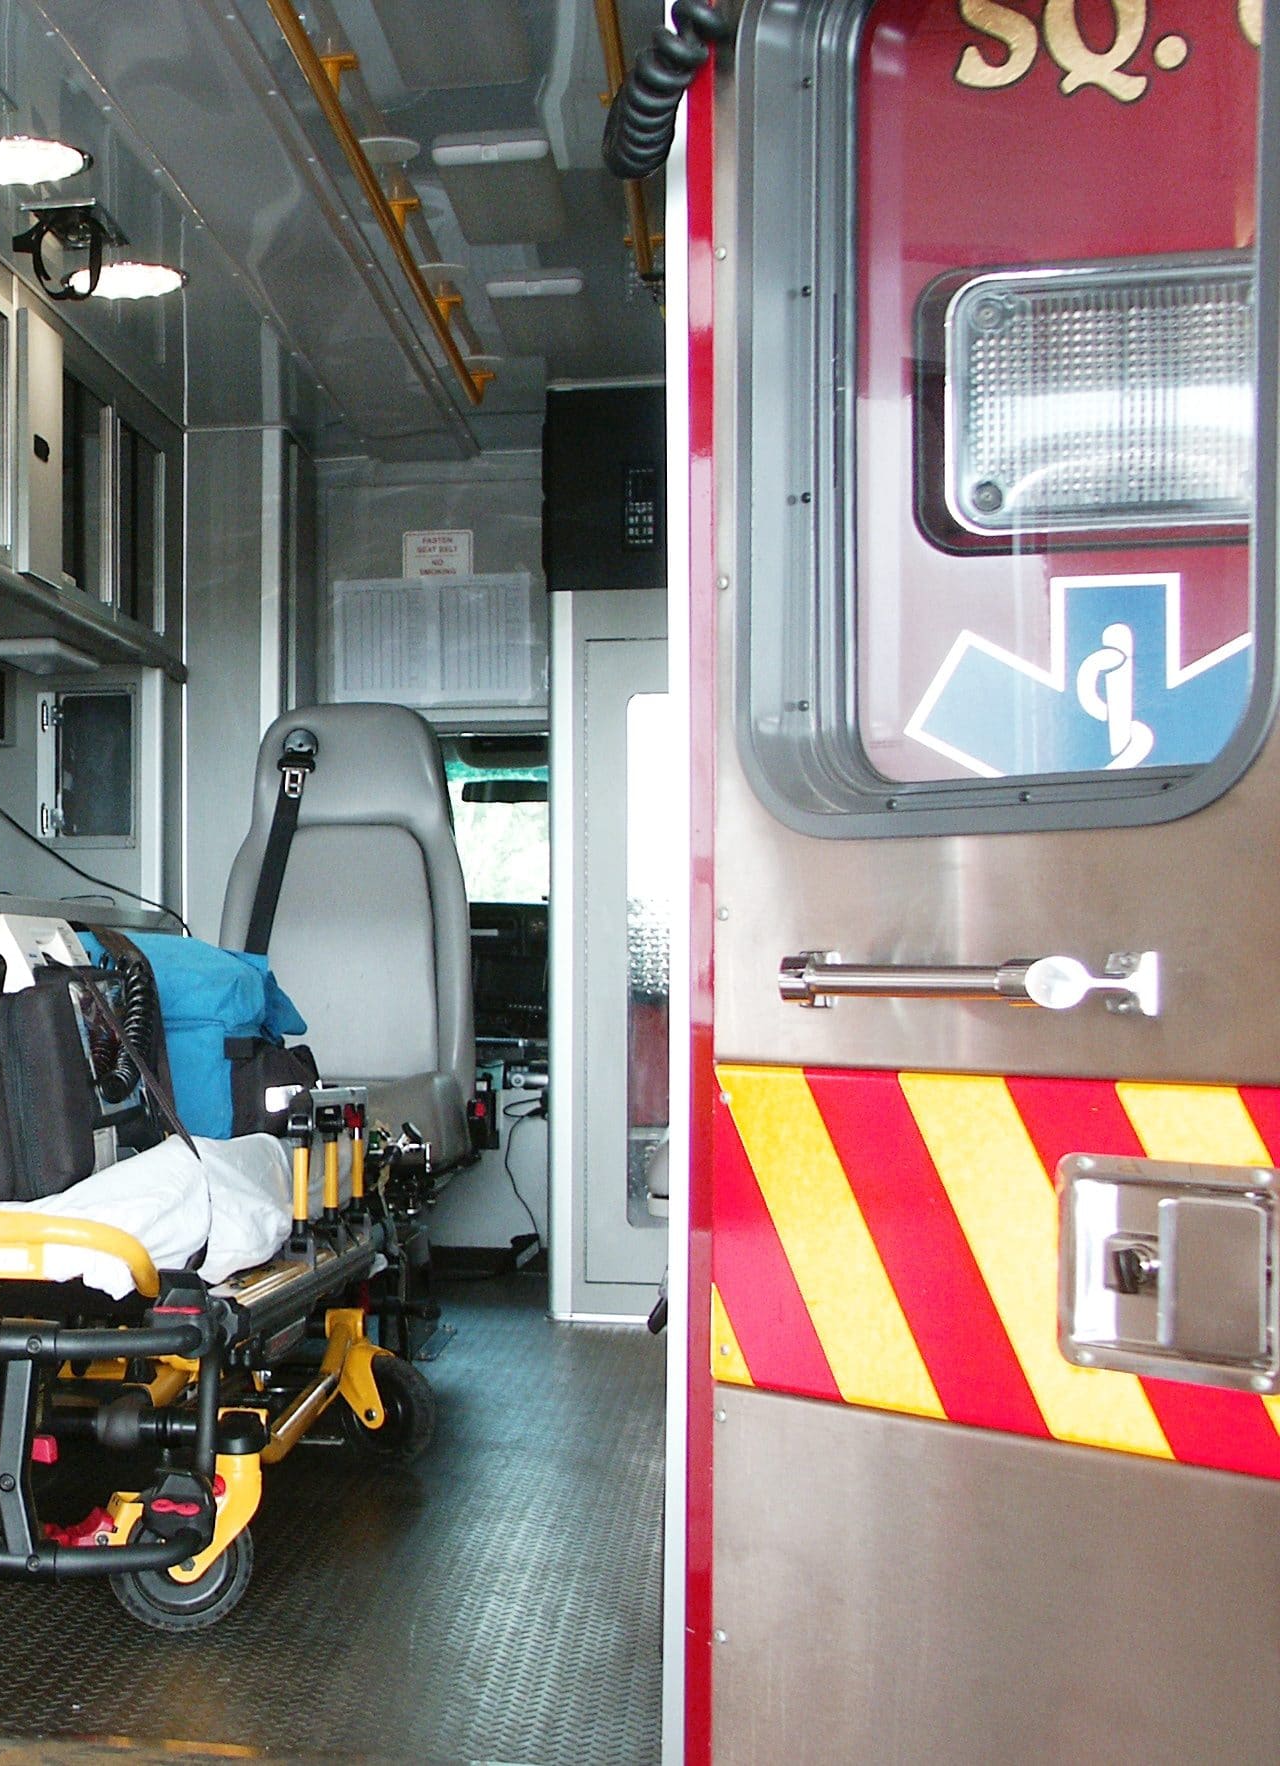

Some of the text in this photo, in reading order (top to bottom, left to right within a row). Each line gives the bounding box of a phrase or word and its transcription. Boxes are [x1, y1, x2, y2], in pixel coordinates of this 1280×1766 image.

[955, 0, 1189, 104] SQ.
[422, 536, 453, 544] FASTEN
[432, 558, 444, 566] NO
